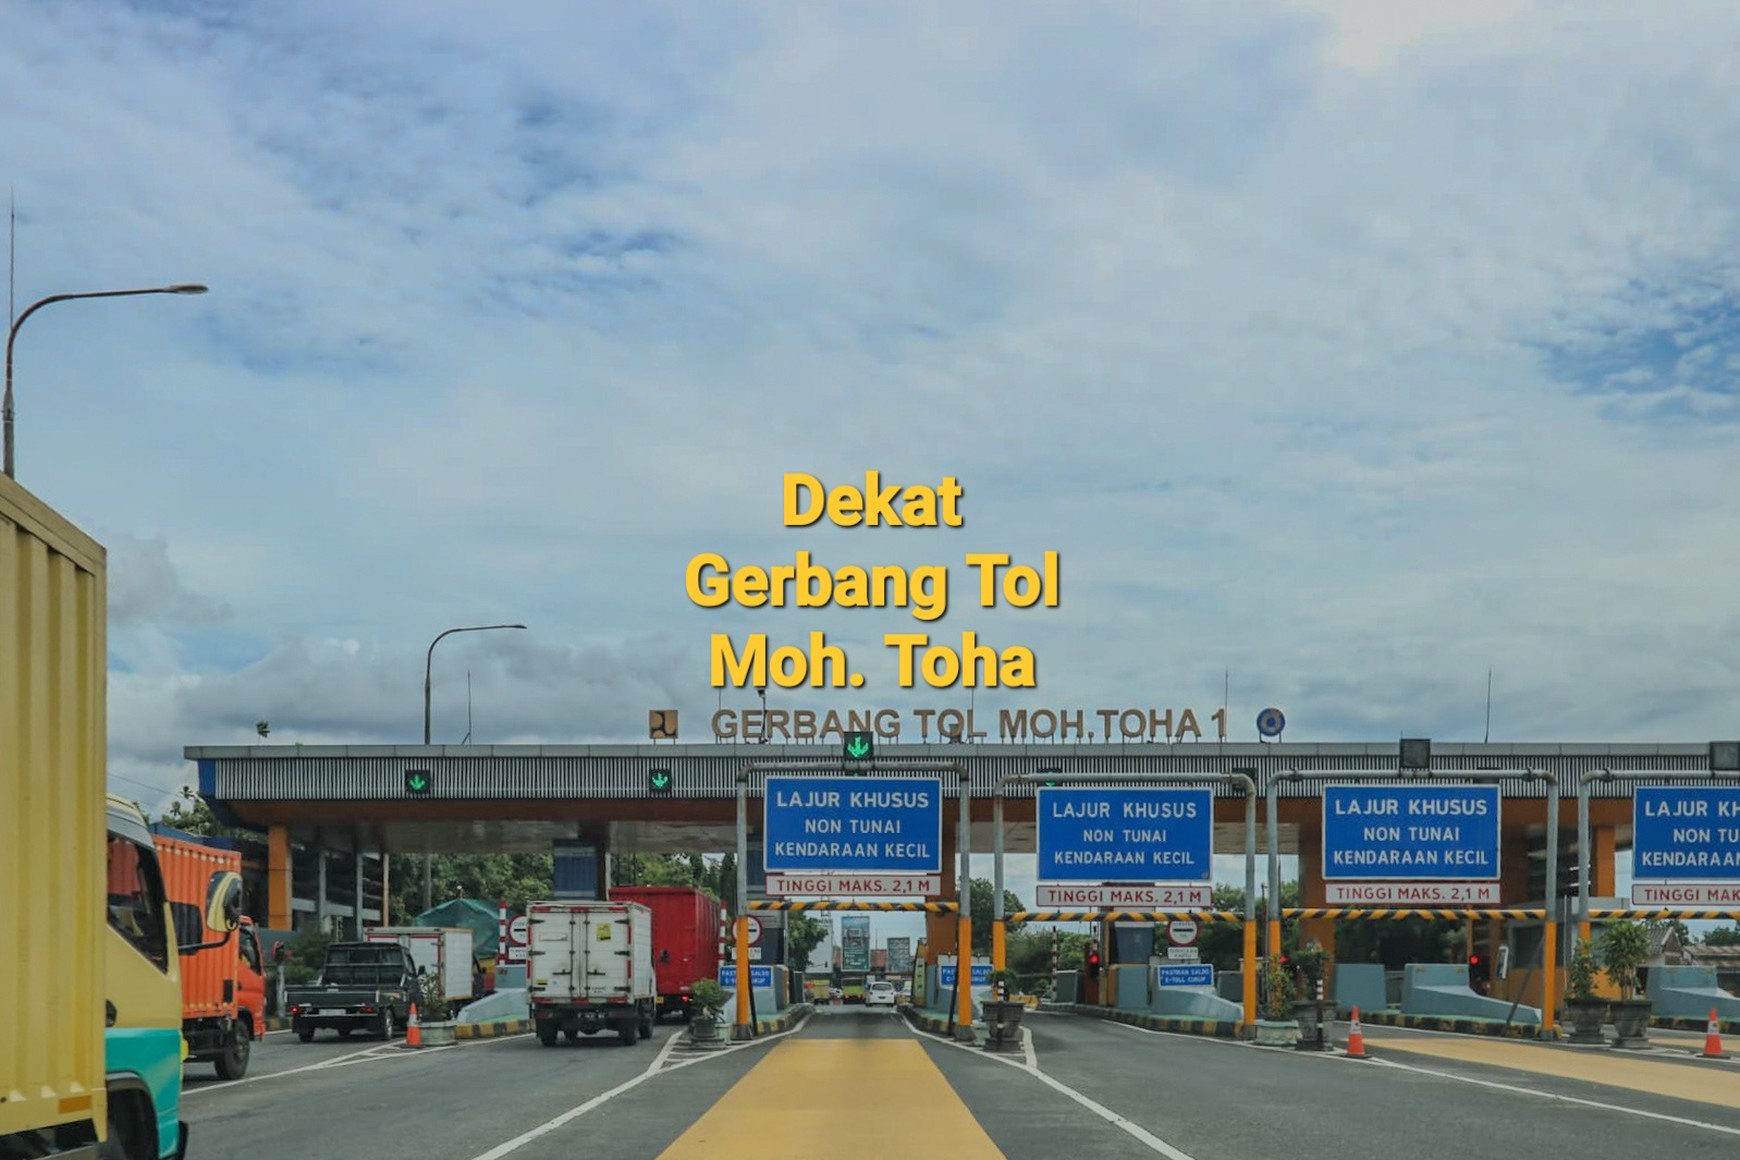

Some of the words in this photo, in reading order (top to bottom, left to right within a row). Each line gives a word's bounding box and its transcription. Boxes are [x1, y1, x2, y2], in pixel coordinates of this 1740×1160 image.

[712, 709, 901, 738] GERBANG
[914, 709, 987, 738] TOL
[777, 791, 840, 807] LAJUR
[850, 791, 929, 808] KHUSUS
[1335, 799, 1399, 815] LAJUR
[1408, 799, 1488, 815] KHUSUS
[1053, 802, 1110, 818] LAJUR
[1123, 802, 1197, 818] KHUSUS
[1645, 801, 1708, 816] LAJUR
[804, 819, 842, 834] NON
[850, 819, 901, 834] TUNAI
[1364, 827, 1400, 841] NON
[1408, 827, 1460, 841] TUNAI
[1083, 830, 1113, 842] NON
[1123, 830, 1167, 842] TUNAI
[1673, 828, 1710, 843] NON
[775, 842, 878, 857] KENDARAAN
[885, 843, 930, 858] KECIL
[1334, 850, 1438, 865] KENDARAAN
[1444, 850, 1489, 865] KECIL
[1054, 851, 1145, 865] KENDARAAN
[1153, 851, 1195, 865] KECIL
[776, 879, 832, 892] TINGGI
[839, 879, 887, 892] MAKS.
[918, 879, 930, 892] M
[1048, 889, 1103, 902] TINGGI
[1111, 889, 1159, 902] MAKS.
[1189, 889, 1201, 902] M
[1337, 887, 1392, 900] TINGGI
[1398, 887, 1445, 900] MAKS.
[1478, 887, 1490, 900] M
[1644, 889, 1700, 902] TINGGI
